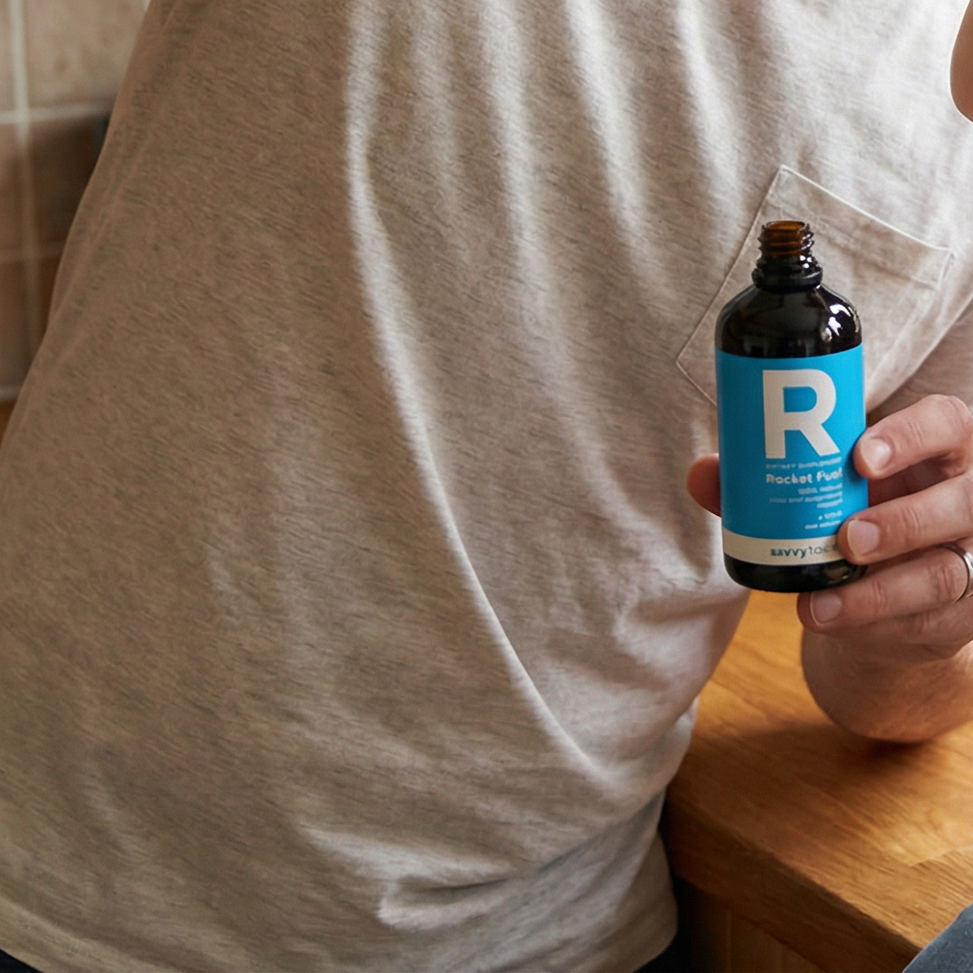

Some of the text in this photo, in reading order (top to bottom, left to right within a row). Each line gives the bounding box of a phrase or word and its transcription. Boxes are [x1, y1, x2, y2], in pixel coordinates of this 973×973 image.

[763, 369, 840, 458] R
[766, 466, 843, 484] Rocket Fuel
